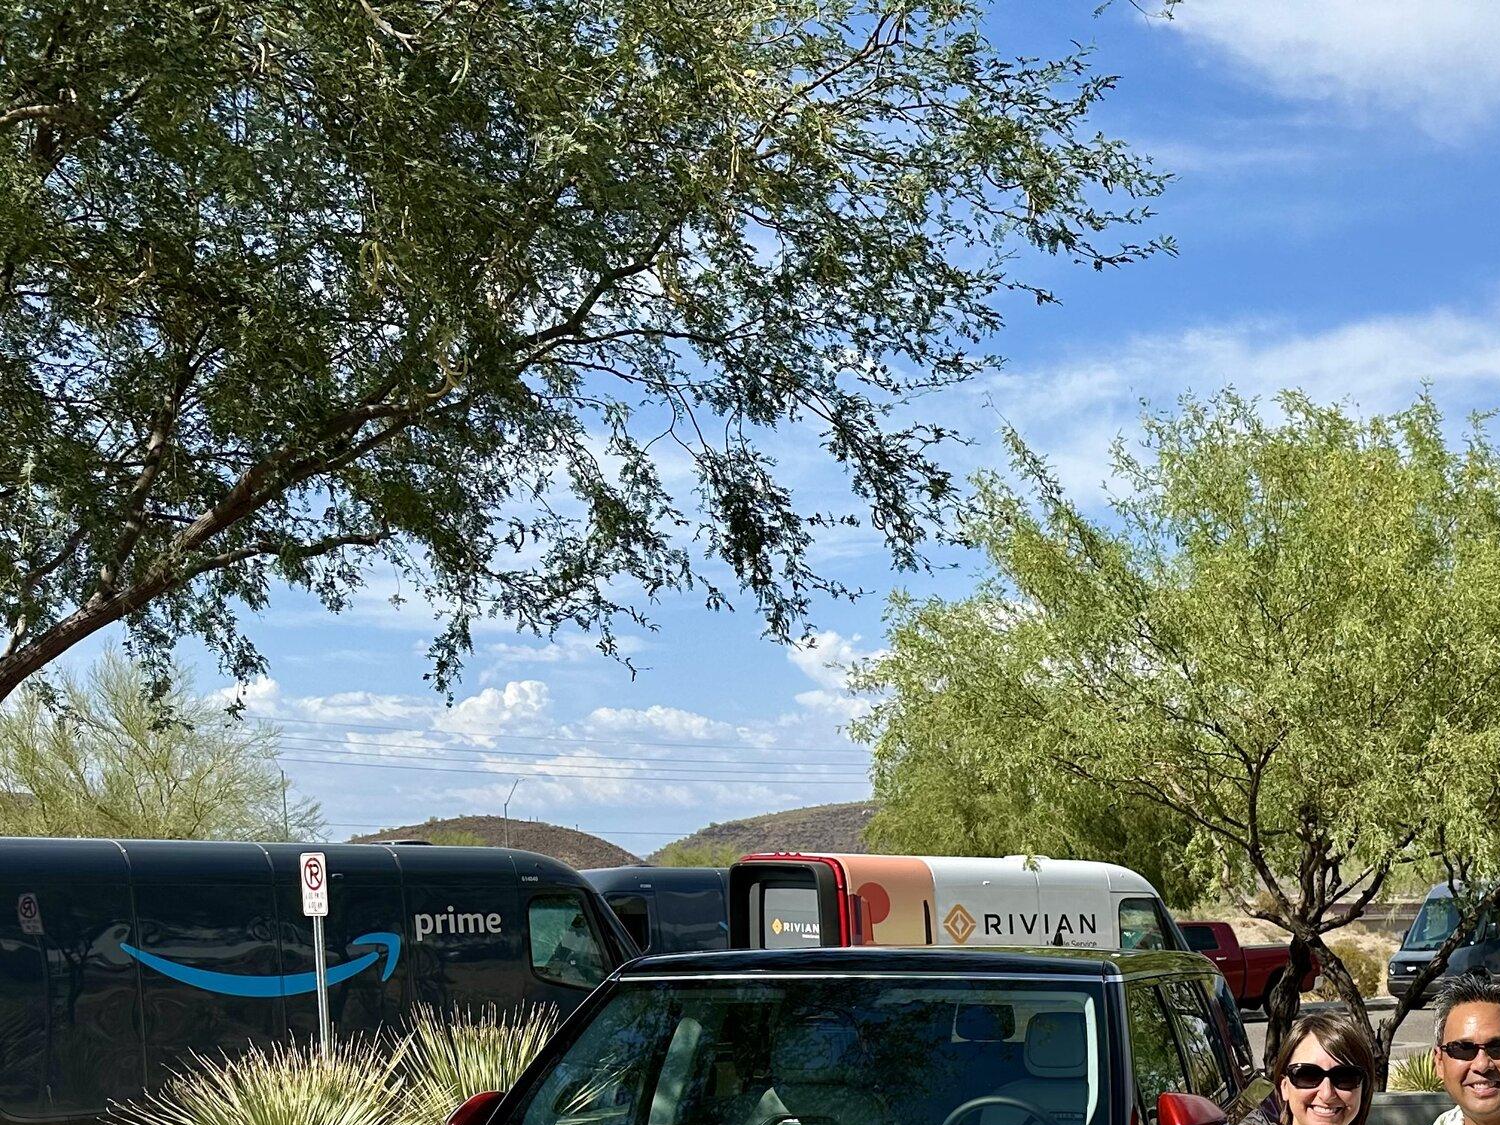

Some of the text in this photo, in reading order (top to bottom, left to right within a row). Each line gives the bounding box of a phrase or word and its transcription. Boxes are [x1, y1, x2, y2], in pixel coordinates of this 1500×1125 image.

[414, 905, 502, 942] prime
[783, 922, 820, 933] RIVIAN
[984, 913, 1096, 935] RIVIAN
